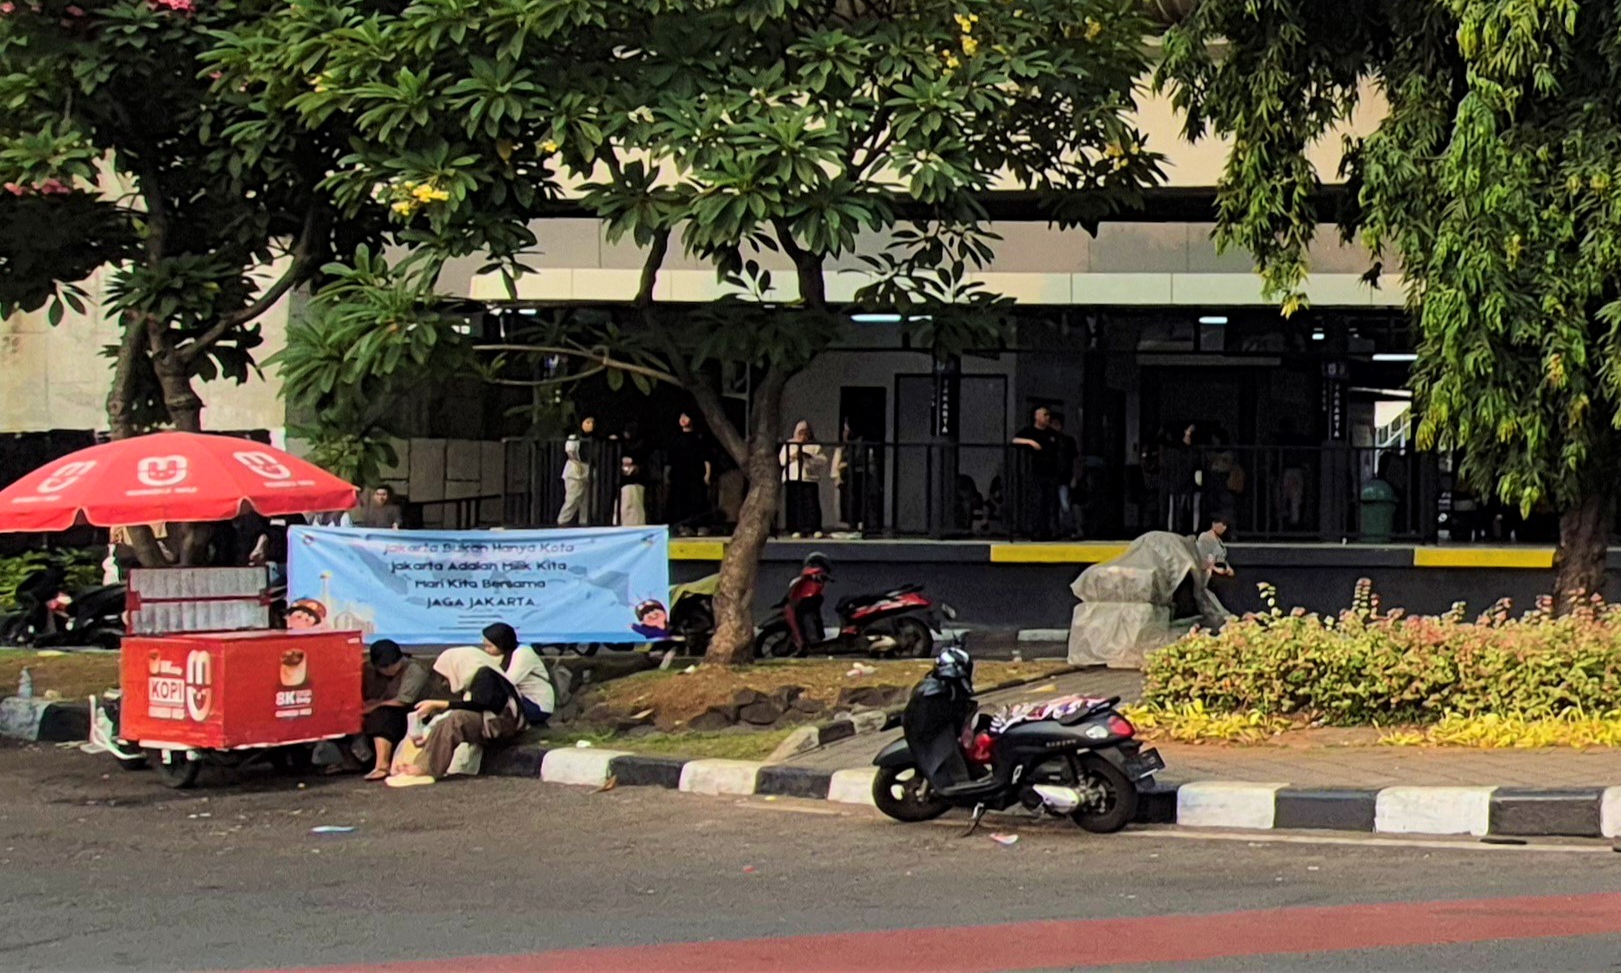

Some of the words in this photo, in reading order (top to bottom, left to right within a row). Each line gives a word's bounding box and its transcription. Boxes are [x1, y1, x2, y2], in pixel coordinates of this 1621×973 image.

[536, 560, 567, 571] Kita
[447, 579, 478, 589] Kita
[482, 579, 546, 589] Bersama
[427, 597, 464, 609] JAGA
[469, 597, 535, 609] JAKARTA
[152, 681, 182, 699] KOPI
[275, 690, 296, 706] 8K
